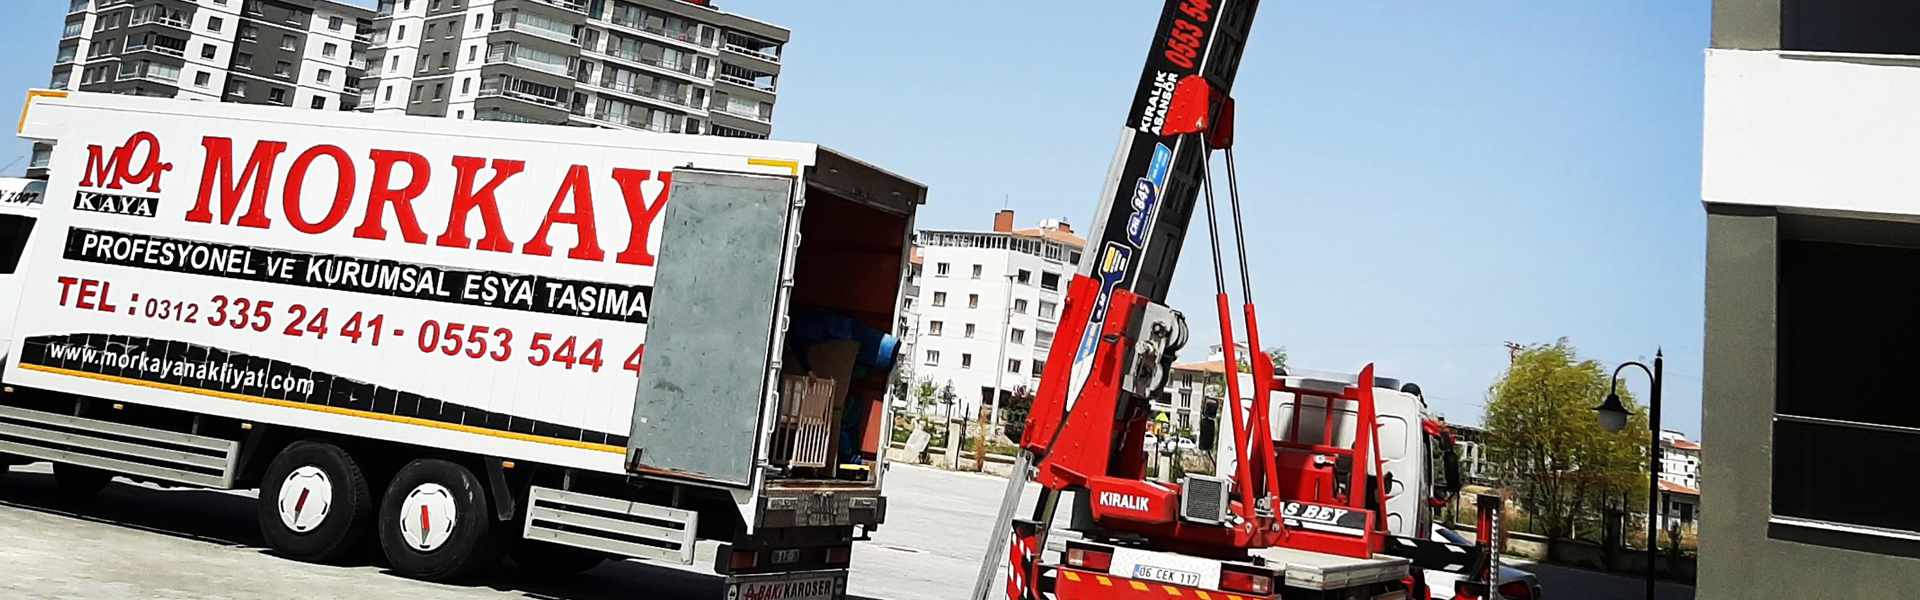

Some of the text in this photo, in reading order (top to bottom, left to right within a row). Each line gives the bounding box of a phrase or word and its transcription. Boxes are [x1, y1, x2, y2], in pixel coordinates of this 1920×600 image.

[1165, 19, 1204, 68] 0553
[1139, 70, 1167, 133] KIRALIK
[77, 192, 153, 216] KAYA
[184, 135, 672, 267] MORKAY
[81, 233, 257, 275] PROFESYONEL
[266, 256, 297, 279] VE
[305, 258, 451, 297] KURUMSAL
[463, 274, 534, 307] EŞYA
[57, 276, 116, 313] TEL
[144, 298, 199, 323] 0312
[207, 294, 274, 332] 335
[283, 303, 329, 339] 24
[340, 311, 384, 346] 41
[417, 319, 513, 362] 0553
[527, 332, 604, 373] 544
[49, 343, 315, 395] www.morkayanakliyat.com
[1099, 491, 1149, 512] KIRALIK
[1301, 504, 1348, 525] BEY
[784, 580, 832, 599] KAROSER
[1180, 573, 1198, 585] 117
